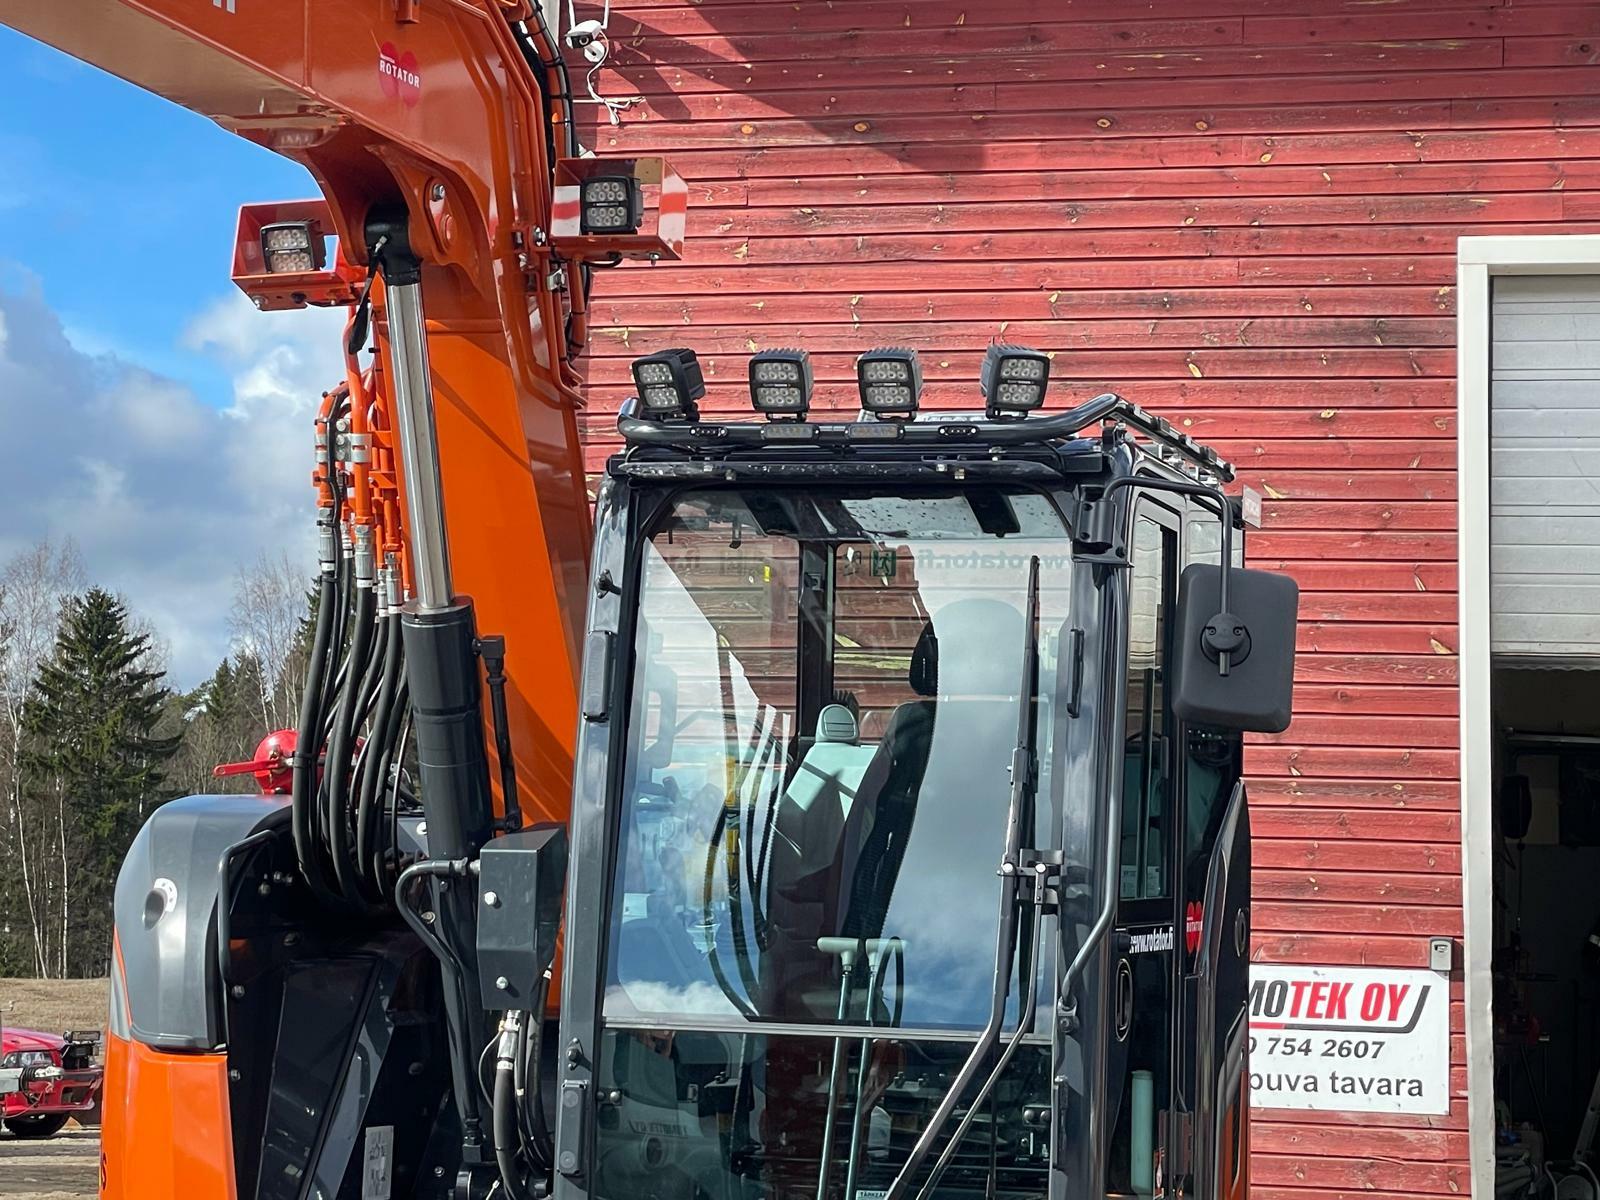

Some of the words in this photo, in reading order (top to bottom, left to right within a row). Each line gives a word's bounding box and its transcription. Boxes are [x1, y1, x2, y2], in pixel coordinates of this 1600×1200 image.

[379, 59, 420, 88] ROTATOR
[1360, 983, 1410, 1022] OY
[1267, 1038, 1312, 1056] 754
[1321, 1039, 1386, 1059] 2607
[1329, 1070, 1424, 1097] tavara
